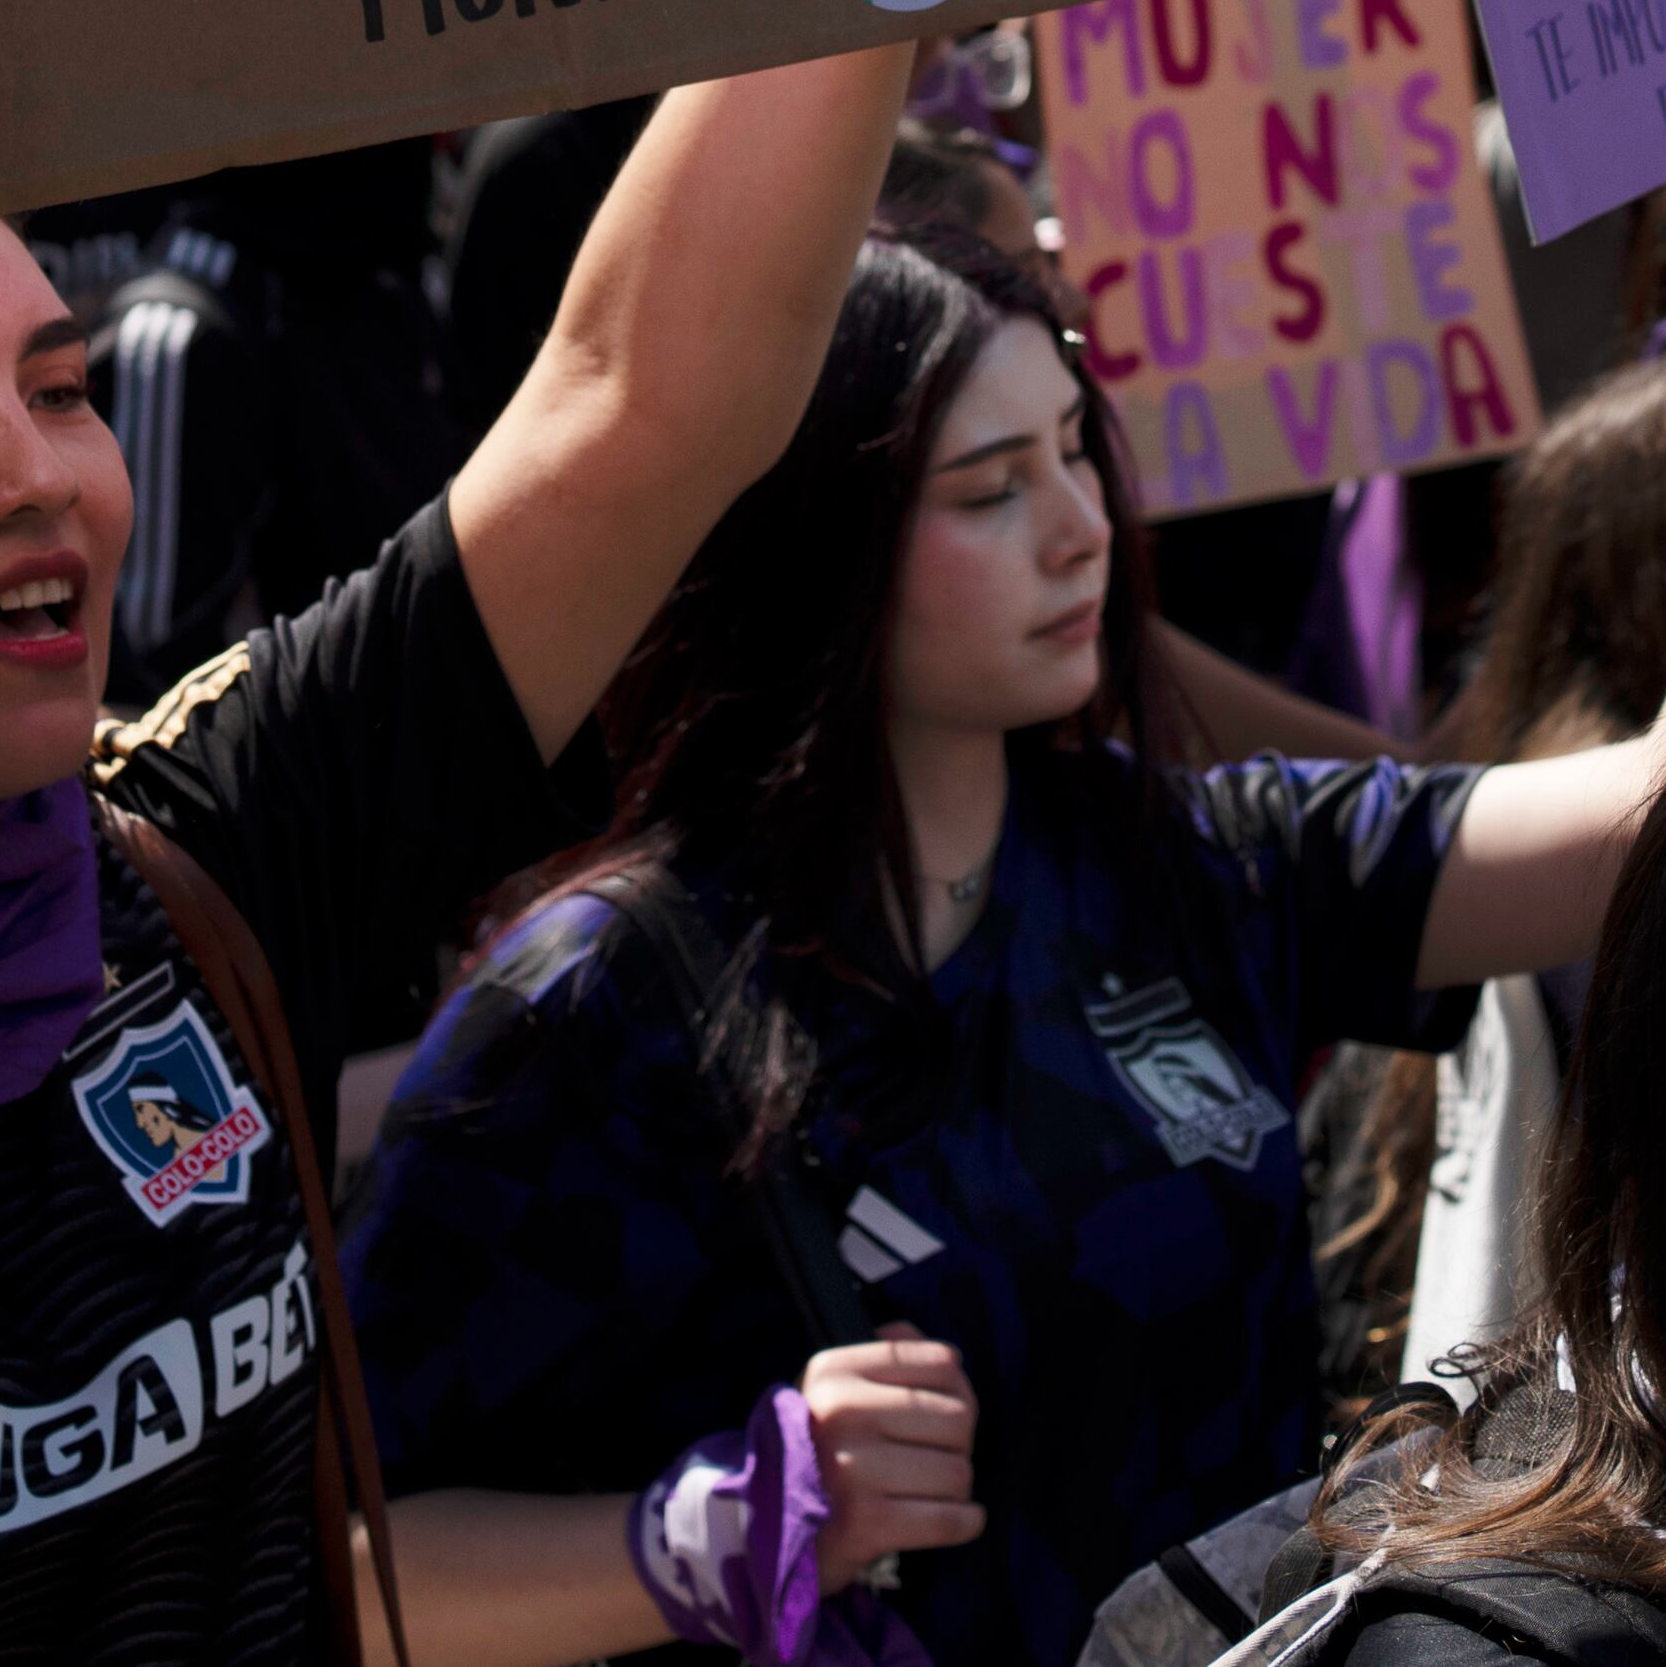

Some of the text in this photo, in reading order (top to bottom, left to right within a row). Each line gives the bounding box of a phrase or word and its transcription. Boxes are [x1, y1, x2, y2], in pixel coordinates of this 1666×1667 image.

[1524, 12, 1581, 103] TE
[1057, 71, 1461, 246] NO NOS
[1085, 200, 1475, 383] CUESTE
[1268, 324, 1517, 482] VIDA
[147, 1112, 256, 1205] COLO-COLO
